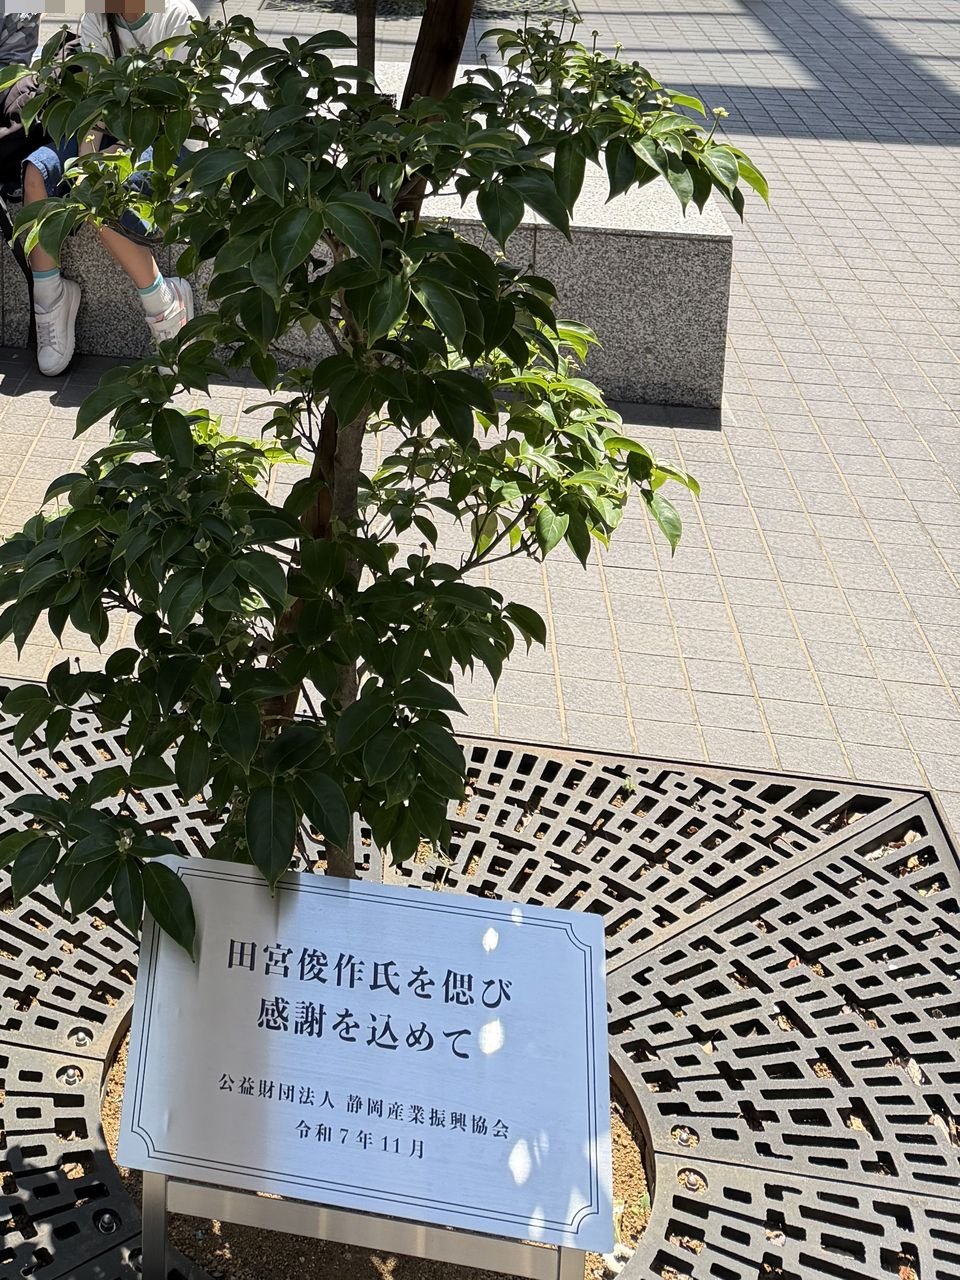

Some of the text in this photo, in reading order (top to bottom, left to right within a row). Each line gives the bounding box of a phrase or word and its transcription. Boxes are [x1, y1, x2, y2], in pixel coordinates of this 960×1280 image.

[227, 938, 513, 1010] 田宮俊作氏を偲び
[256, 996, 472, 1060] 感謝を込めて
[217, 1072, 511, 1140] 公益財団法人 静岡産業振興協会
